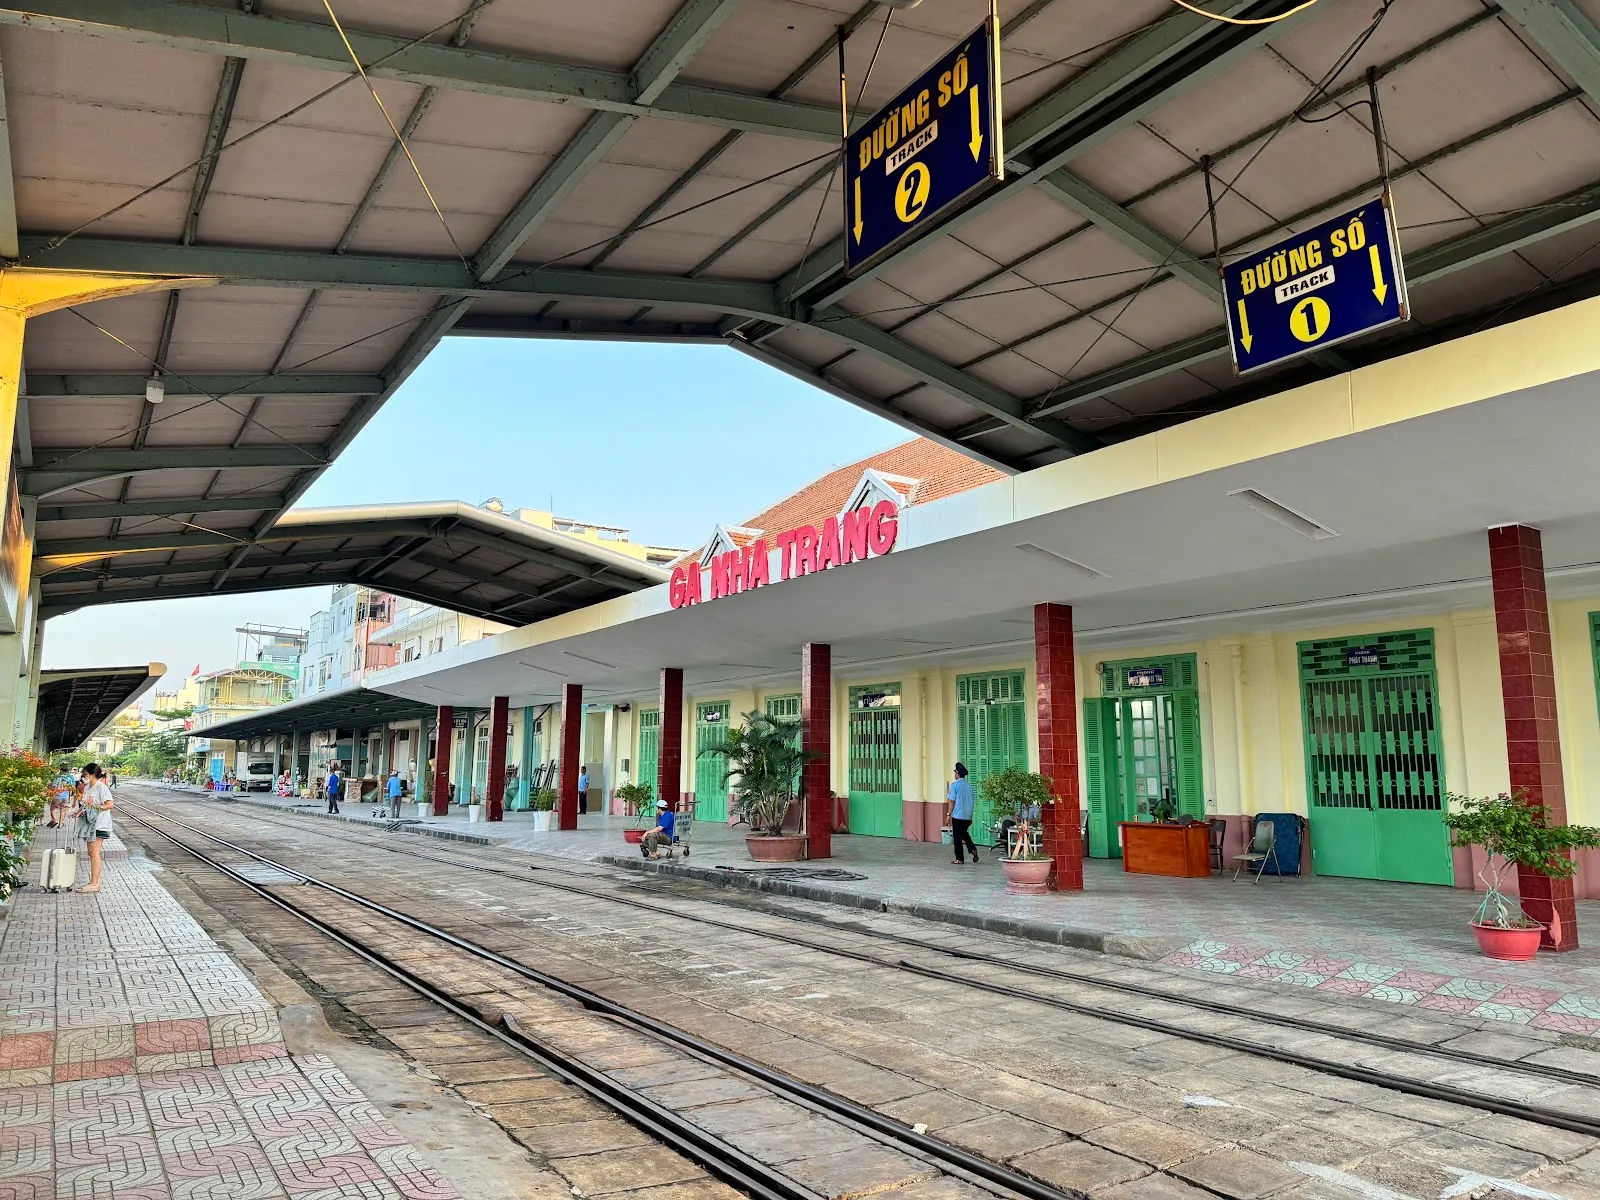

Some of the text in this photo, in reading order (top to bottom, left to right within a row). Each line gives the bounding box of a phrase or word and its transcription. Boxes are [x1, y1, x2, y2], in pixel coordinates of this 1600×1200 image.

[859, 43, 971, 171] ĐƯỜNG SỐ
[890, 125, 933, 168] TRACK
[904, 168, 923, 217] 2
[1240, 210, 1366, 296] ĐƯỜNG SỐ
[1280, 271, 1329, 298] TRACK
[1300, 302, 1318, 336] 1
[669, 499, 899, 609] GA NHA TRANG
